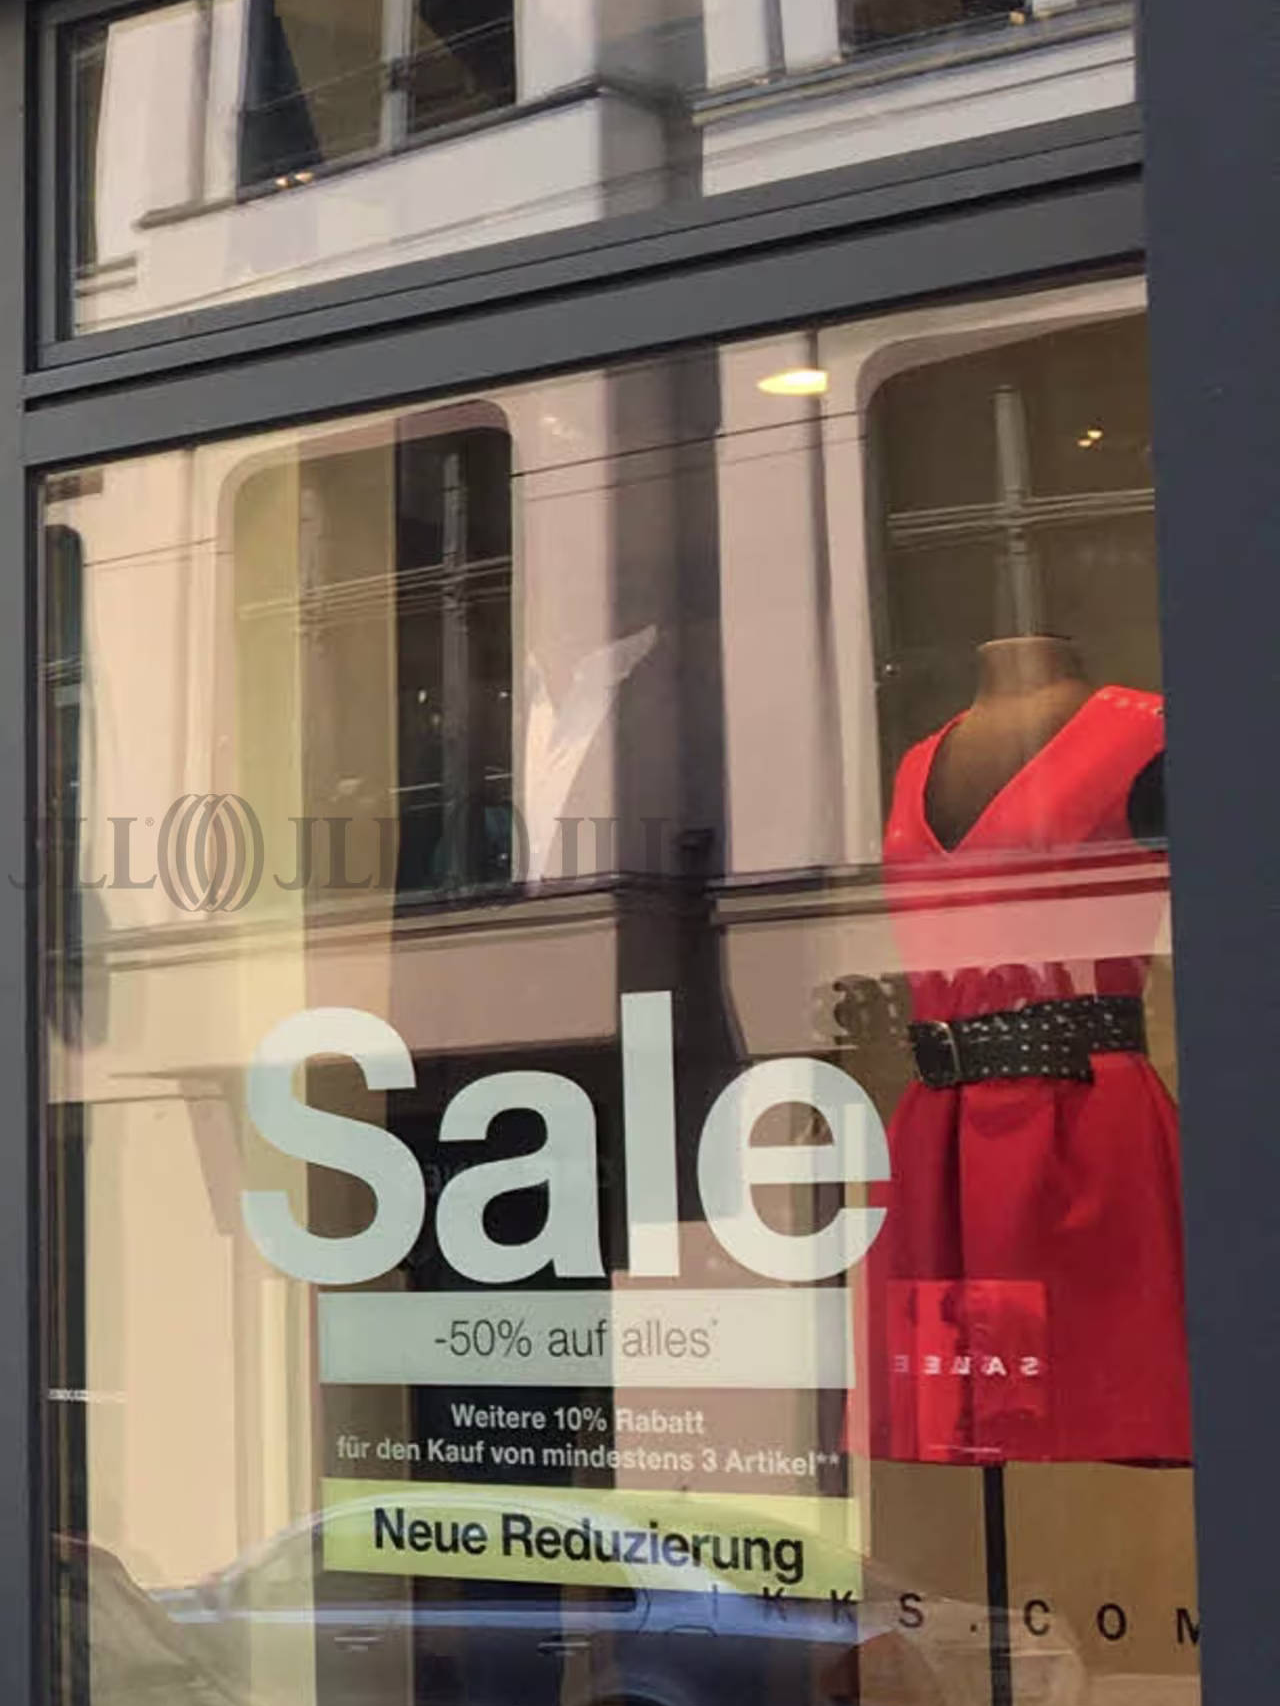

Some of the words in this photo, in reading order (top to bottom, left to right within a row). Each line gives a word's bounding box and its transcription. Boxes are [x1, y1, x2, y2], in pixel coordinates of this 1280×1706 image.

[243, 990, 891, 1285] Sale
[434, 1318, 532, 1358] -50%
[547, 1318, 608, 1358] auf
[450, 1403, 546, 1430] Weitere
[553, 1406, 608, 1433] 10%
[615, 1408, 705, 1435] Rabatt
[336, 1435, 370, 1460] für
[376, 1436, 421, 1462] den
[427, 1438, 485, 1465] Kauf
[491, 1445, 535, 1467] von
[542, 1443, 695, 1472] mindestens
[701, 1448, 718, 1473] 3
[374, 1507, 488, 1555] Neue
[501, 1512, 806, 1585] Reduzierung
